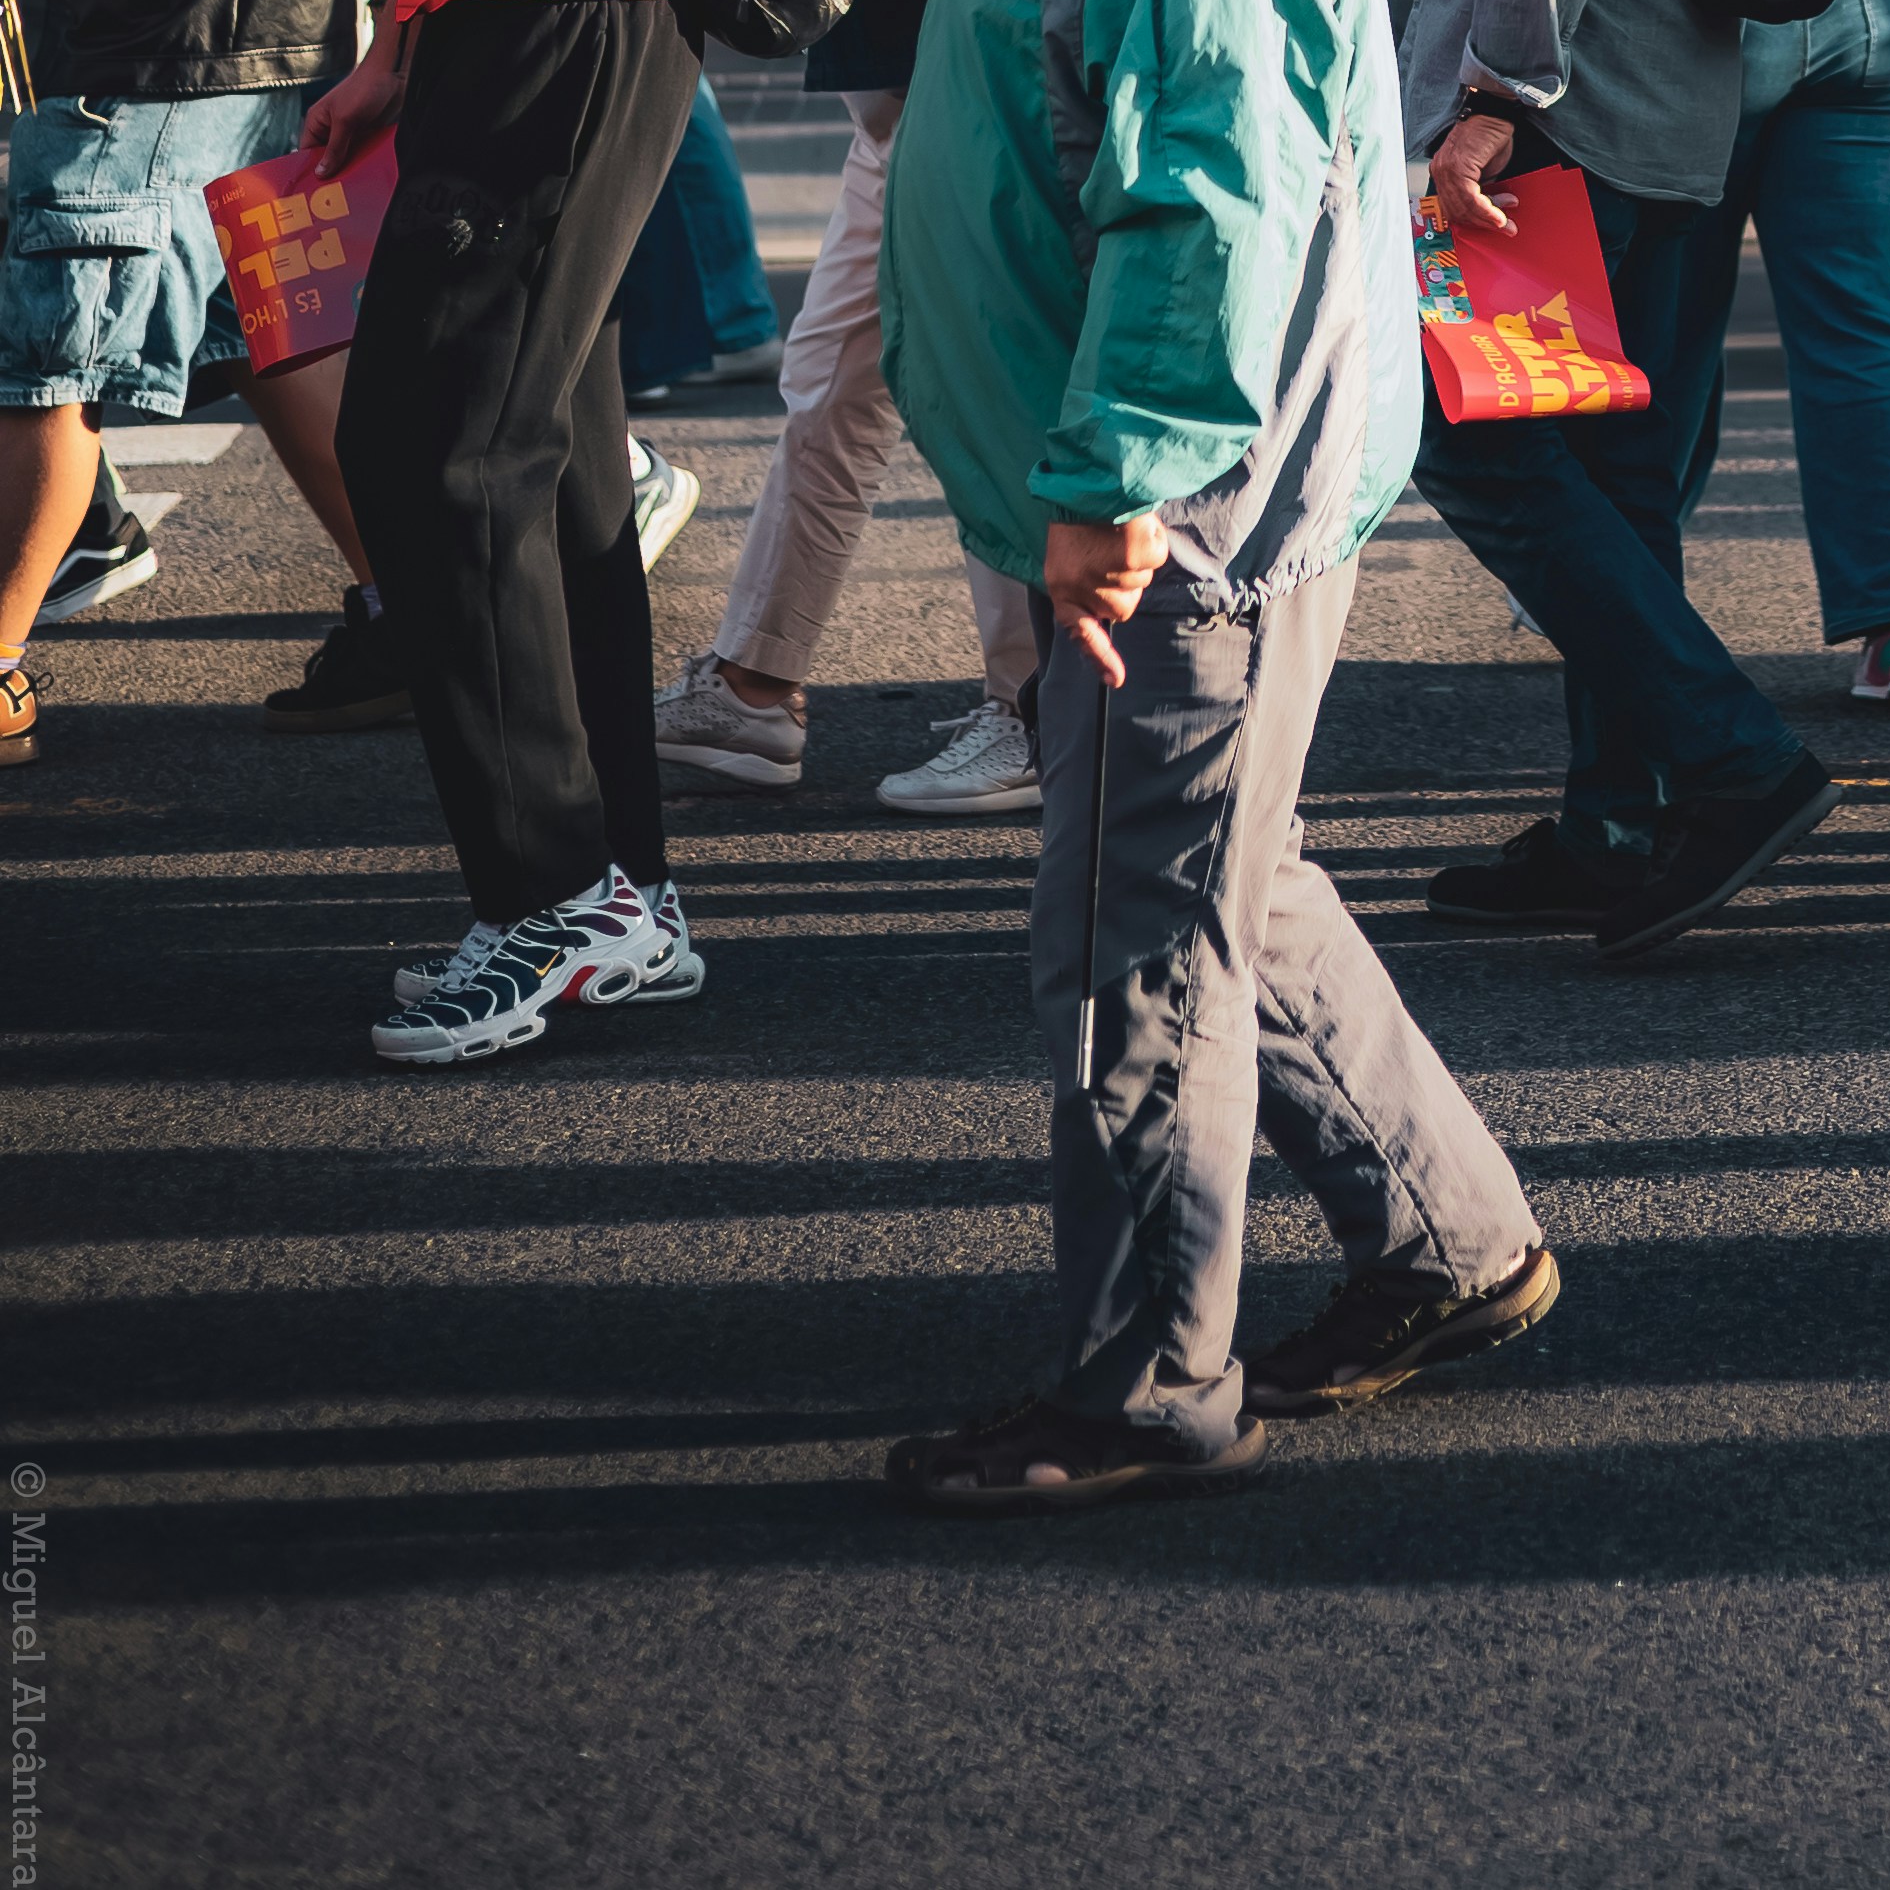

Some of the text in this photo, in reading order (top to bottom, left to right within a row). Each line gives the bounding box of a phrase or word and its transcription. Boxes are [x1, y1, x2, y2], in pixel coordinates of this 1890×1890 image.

[240, 181, 350, 242] DEL
[238, 227, 346, 290] PEL
[294, 288, 322, 316] ÉS
[1470, 334, 1520, 408] D'ACTUAR
[1492, 310, 1570, 418] UTUR
